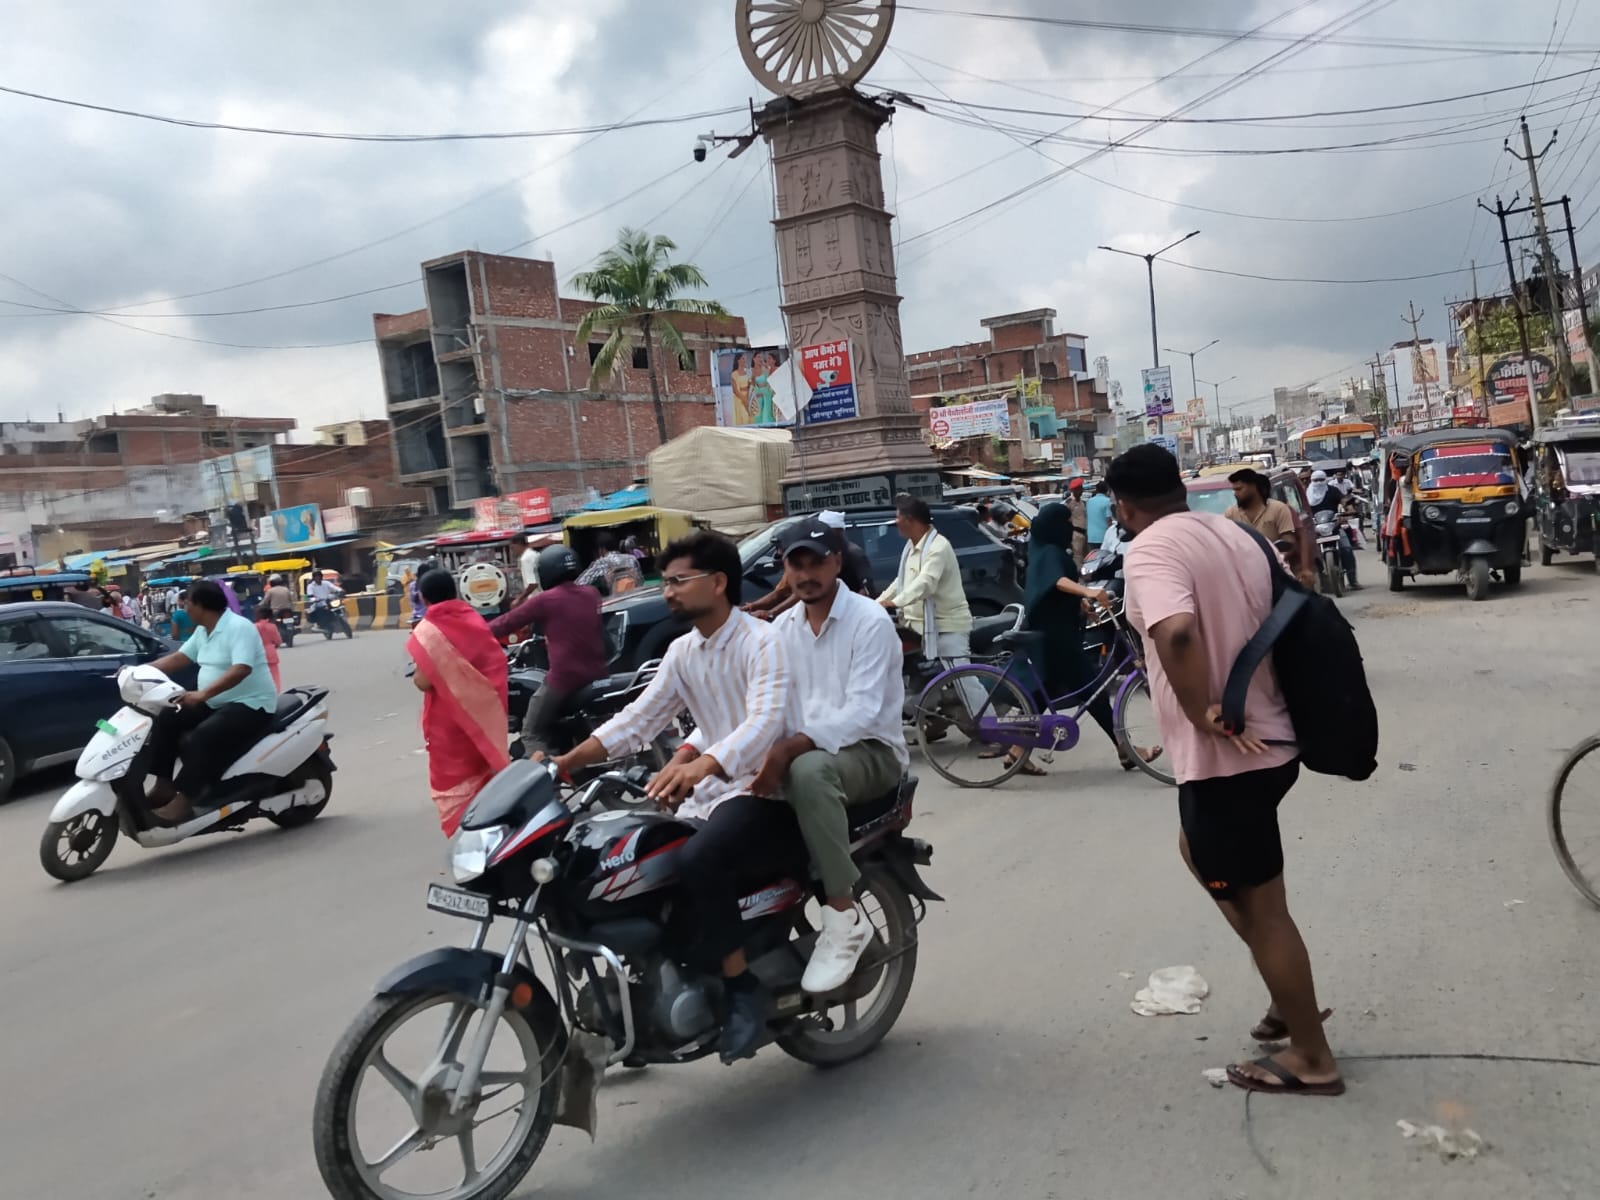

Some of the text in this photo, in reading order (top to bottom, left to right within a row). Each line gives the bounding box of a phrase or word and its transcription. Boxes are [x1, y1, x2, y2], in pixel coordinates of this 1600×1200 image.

[805, 349, 819, 359] आप
[837, 341, 847, 352] की
[102, 734, 141, 760] electric
[600, 851, 635, 871] Hero
